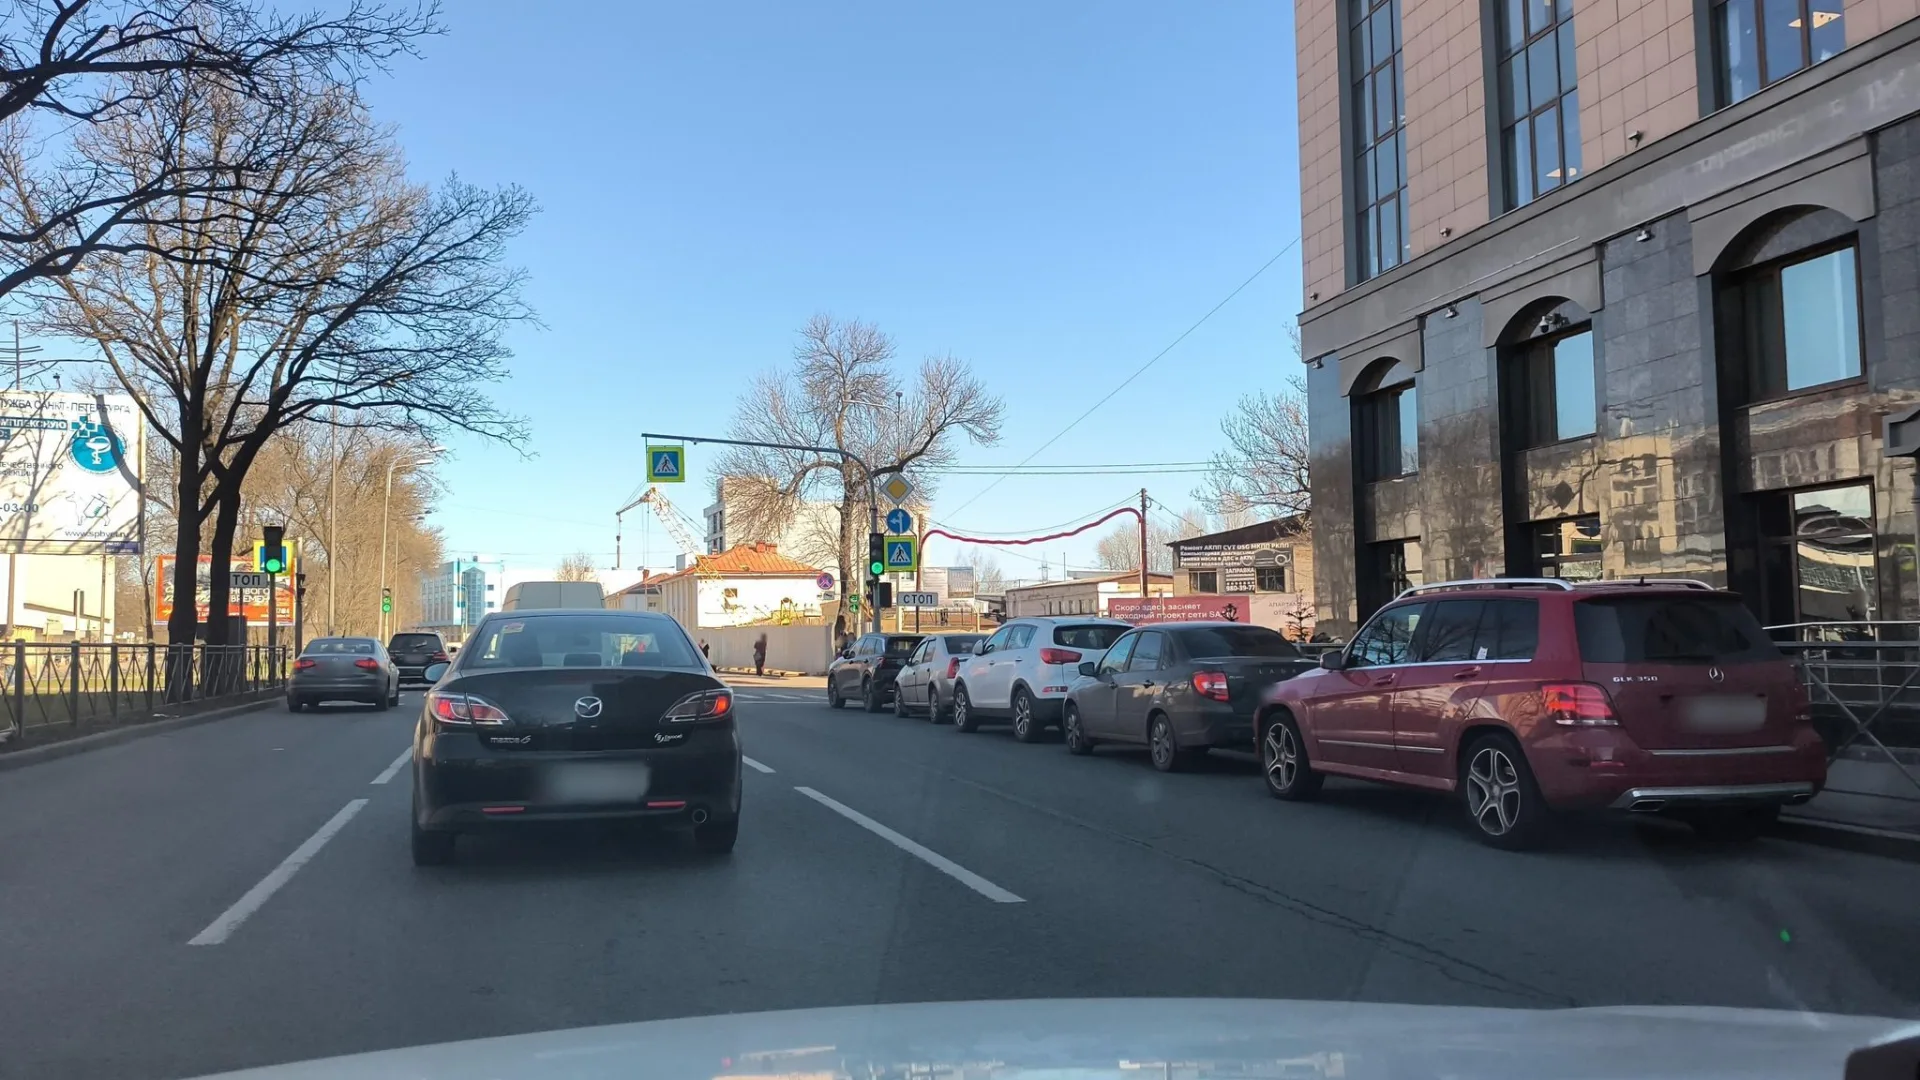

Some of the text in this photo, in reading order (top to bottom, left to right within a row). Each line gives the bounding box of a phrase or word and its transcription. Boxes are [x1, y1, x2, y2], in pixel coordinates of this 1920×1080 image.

[233, 575, 260, 585] ТОП
[903, 594, 933, 604] СТОП
[1114, 604, 1140, 612] Скоро
